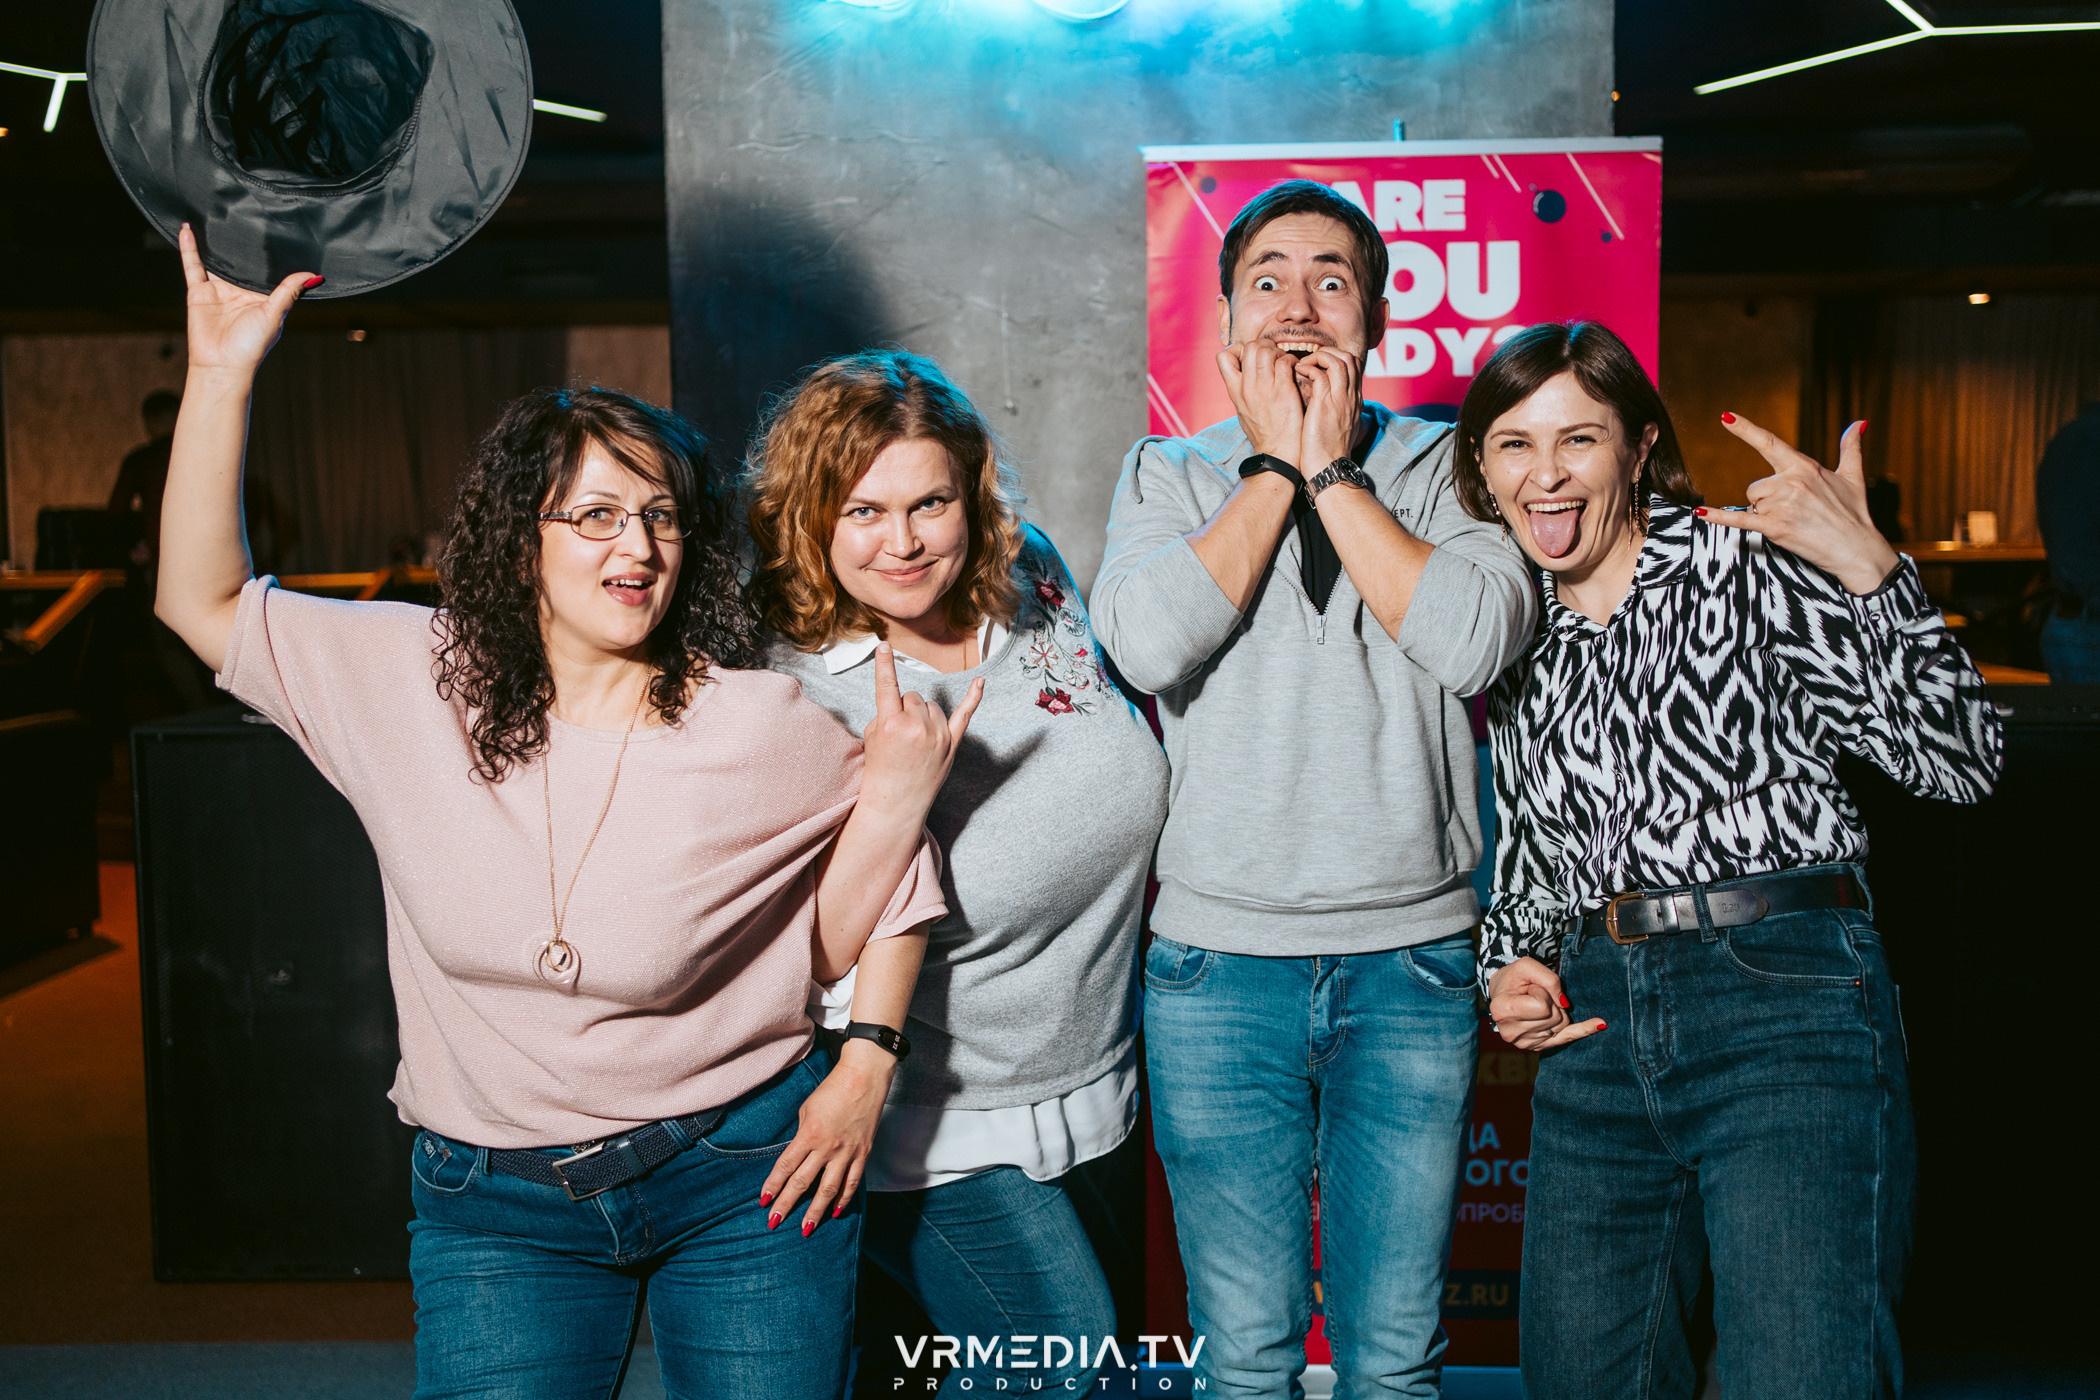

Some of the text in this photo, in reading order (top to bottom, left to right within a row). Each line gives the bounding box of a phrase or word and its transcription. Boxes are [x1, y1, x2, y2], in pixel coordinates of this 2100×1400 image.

[1381, 240, 1520, 321] OU
[1364, 325, 1526, 378] DY
[1393, 508, 1413, 518] EPT.
[1457, 1202, 1525, 1223] ПРОБ
